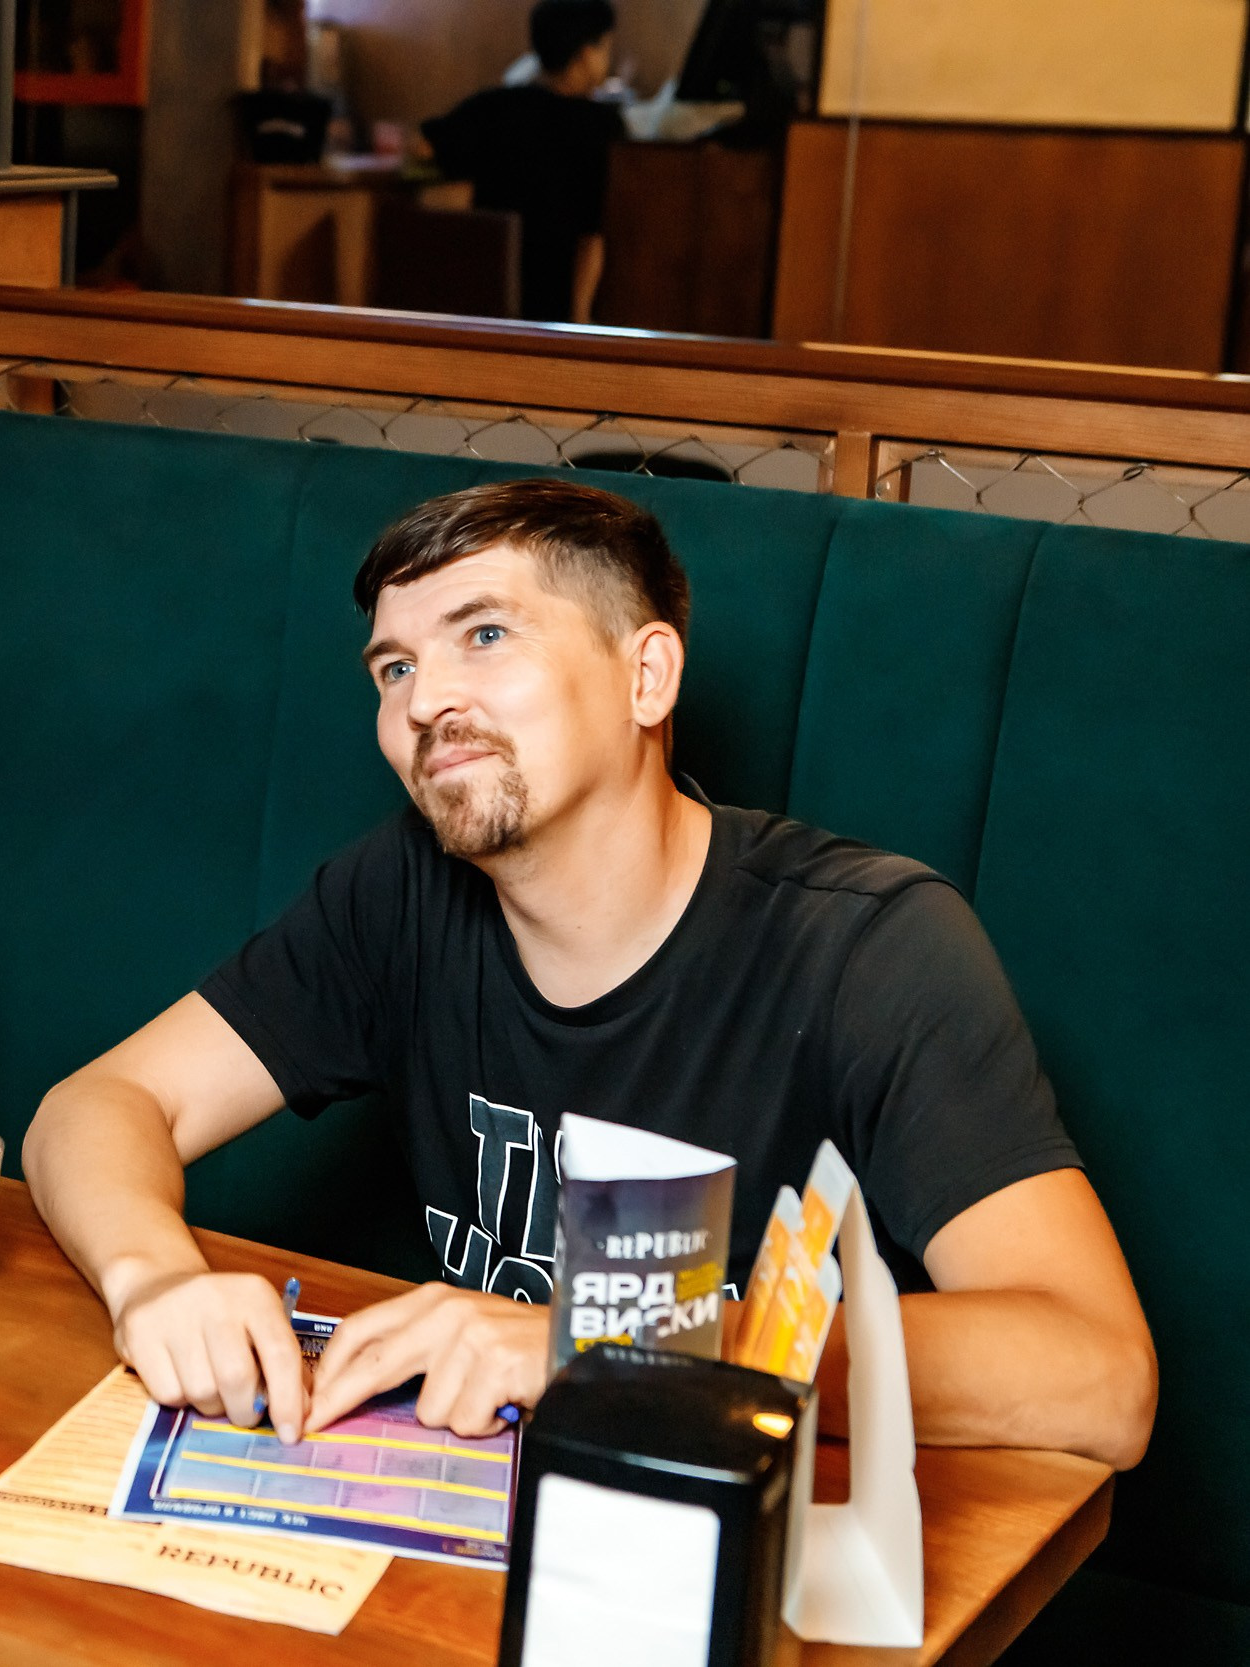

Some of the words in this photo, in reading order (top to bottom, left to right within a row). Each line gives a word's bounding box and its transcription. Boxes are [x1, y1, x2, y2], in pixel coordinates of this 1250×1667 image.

[572, 1271, 675, 1310] ЯРД
[570, 1291, 720, 1339] ВИСКИ
[158, 1544, 345, 1601] REPUBLIC
